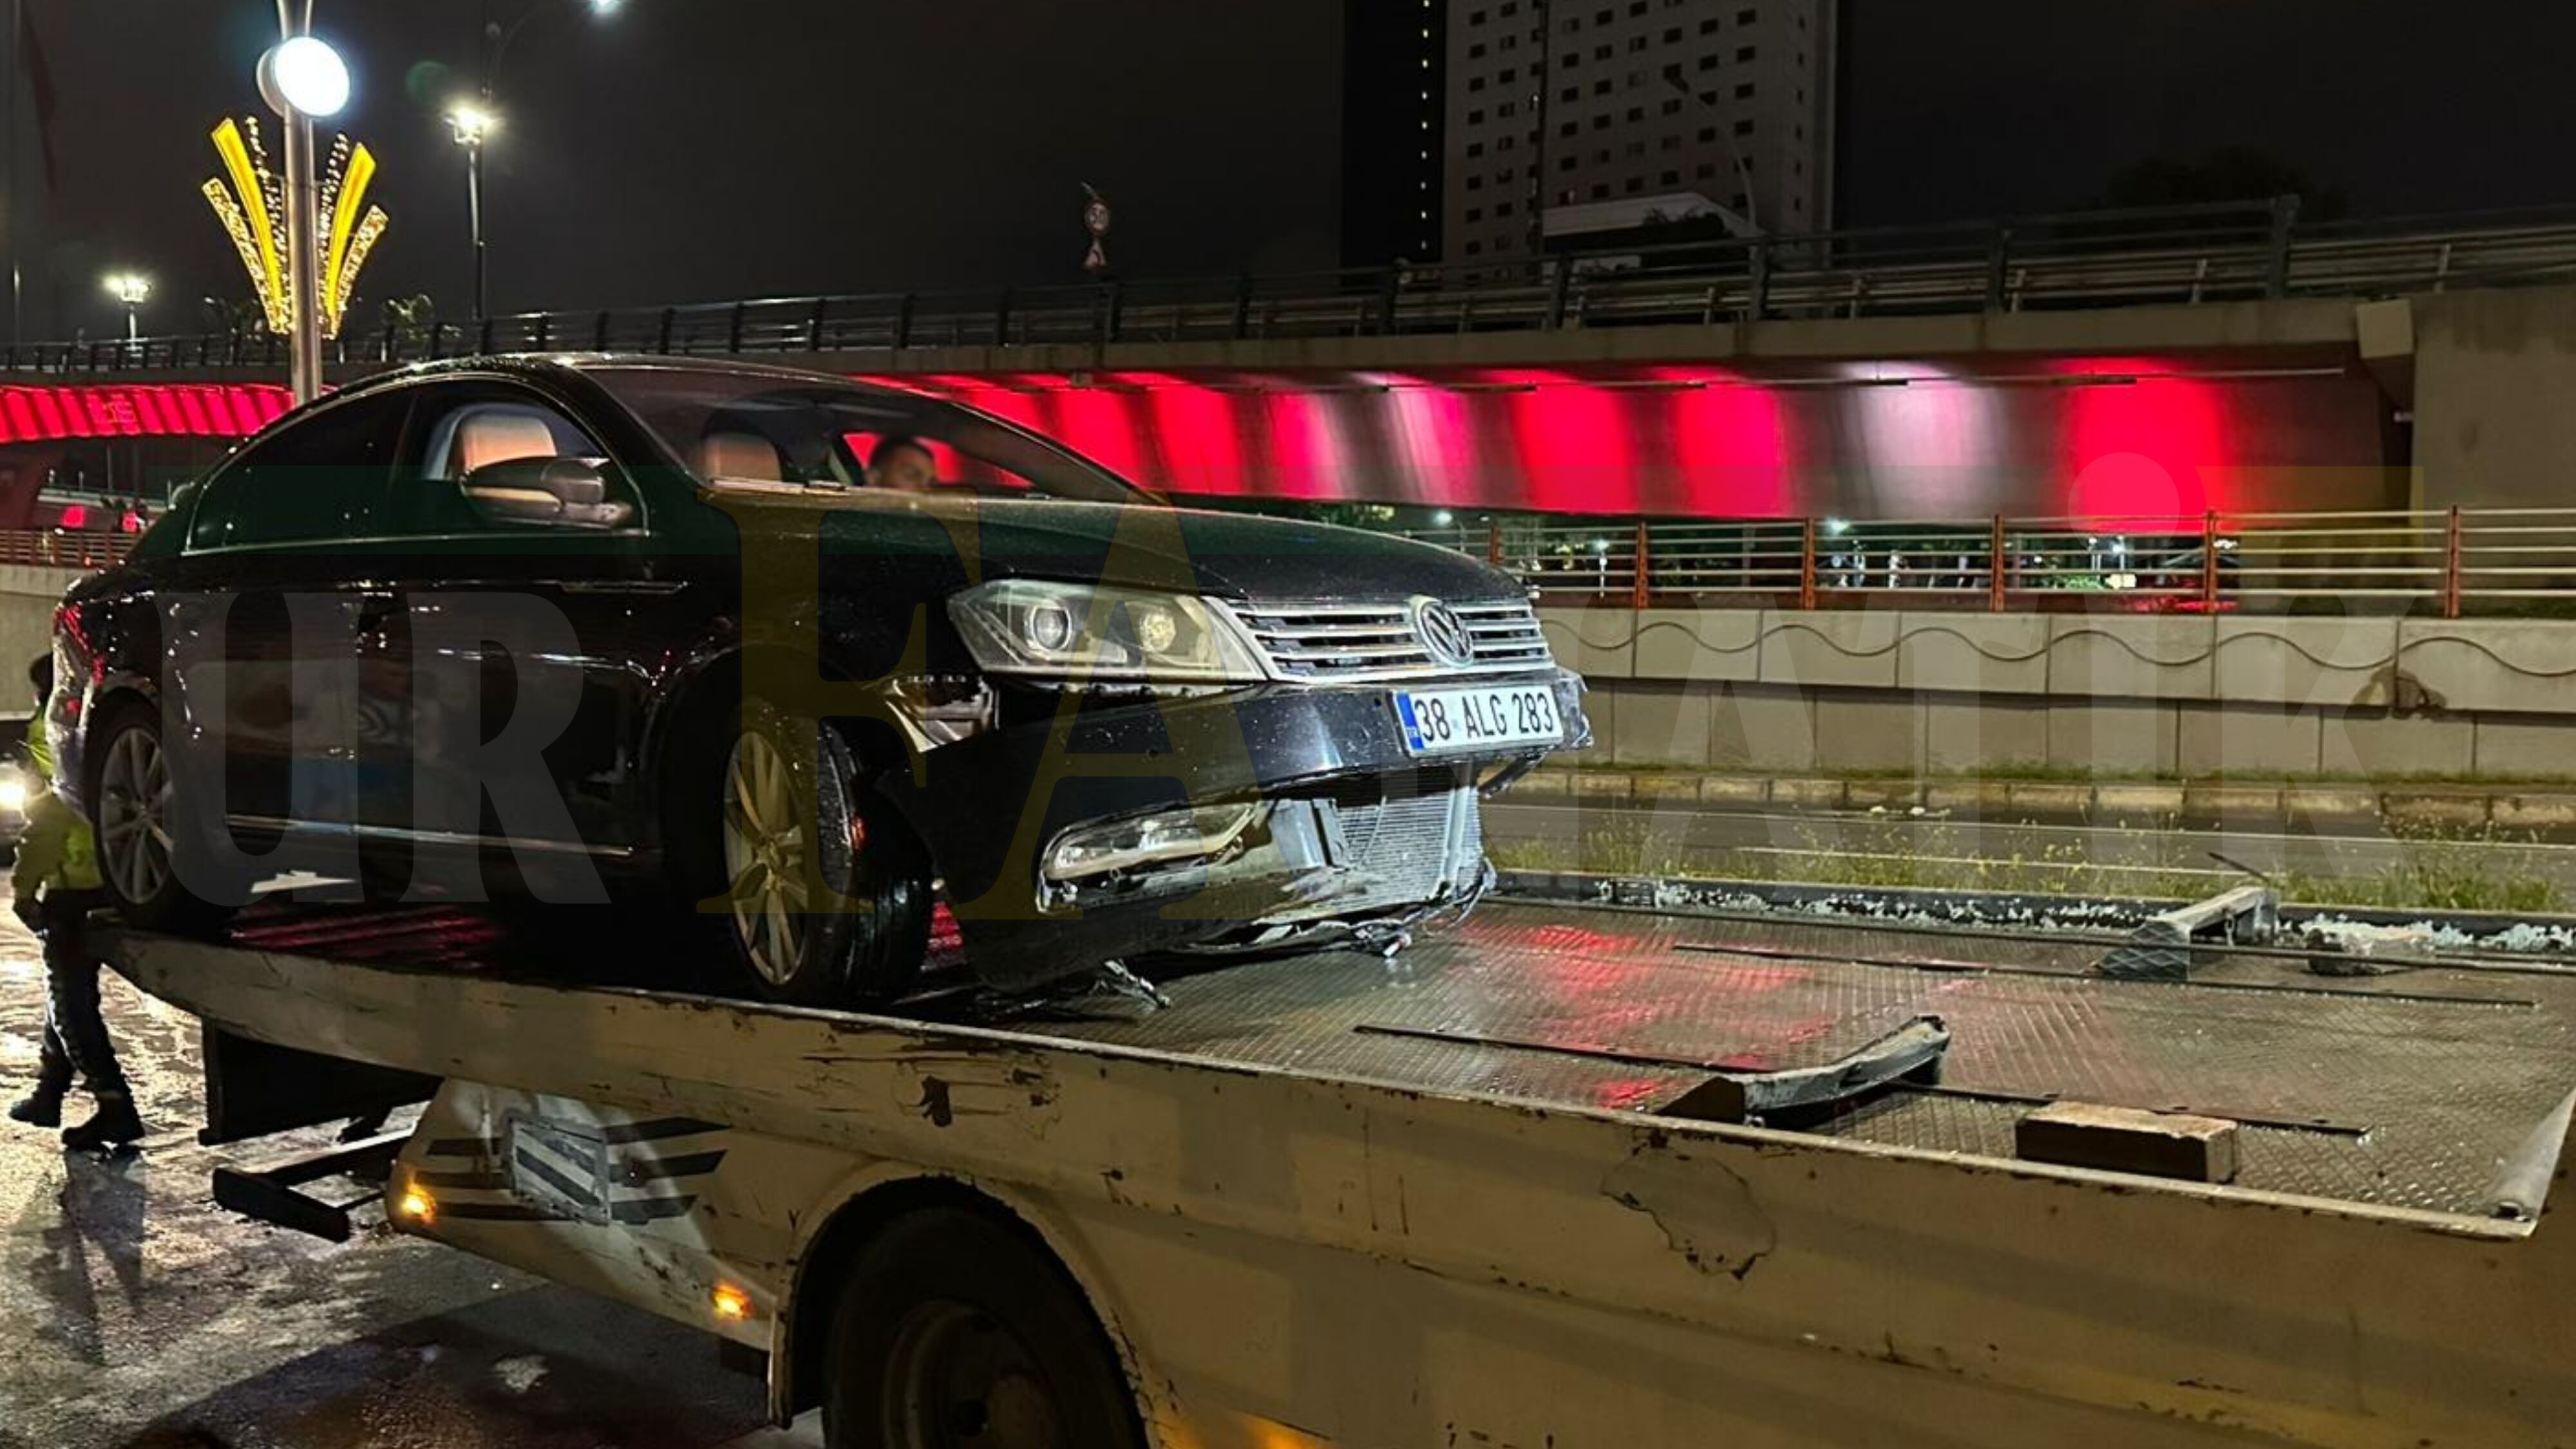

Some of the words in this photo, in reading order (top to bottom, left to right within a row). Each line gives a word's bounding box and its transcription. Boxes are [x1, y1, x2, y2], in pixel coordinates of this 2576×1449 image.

[1414, 698, 1450, 741] 38
[1462, 694, 1507, 738] ALG
[1511, 692, 1553, 734] 283
